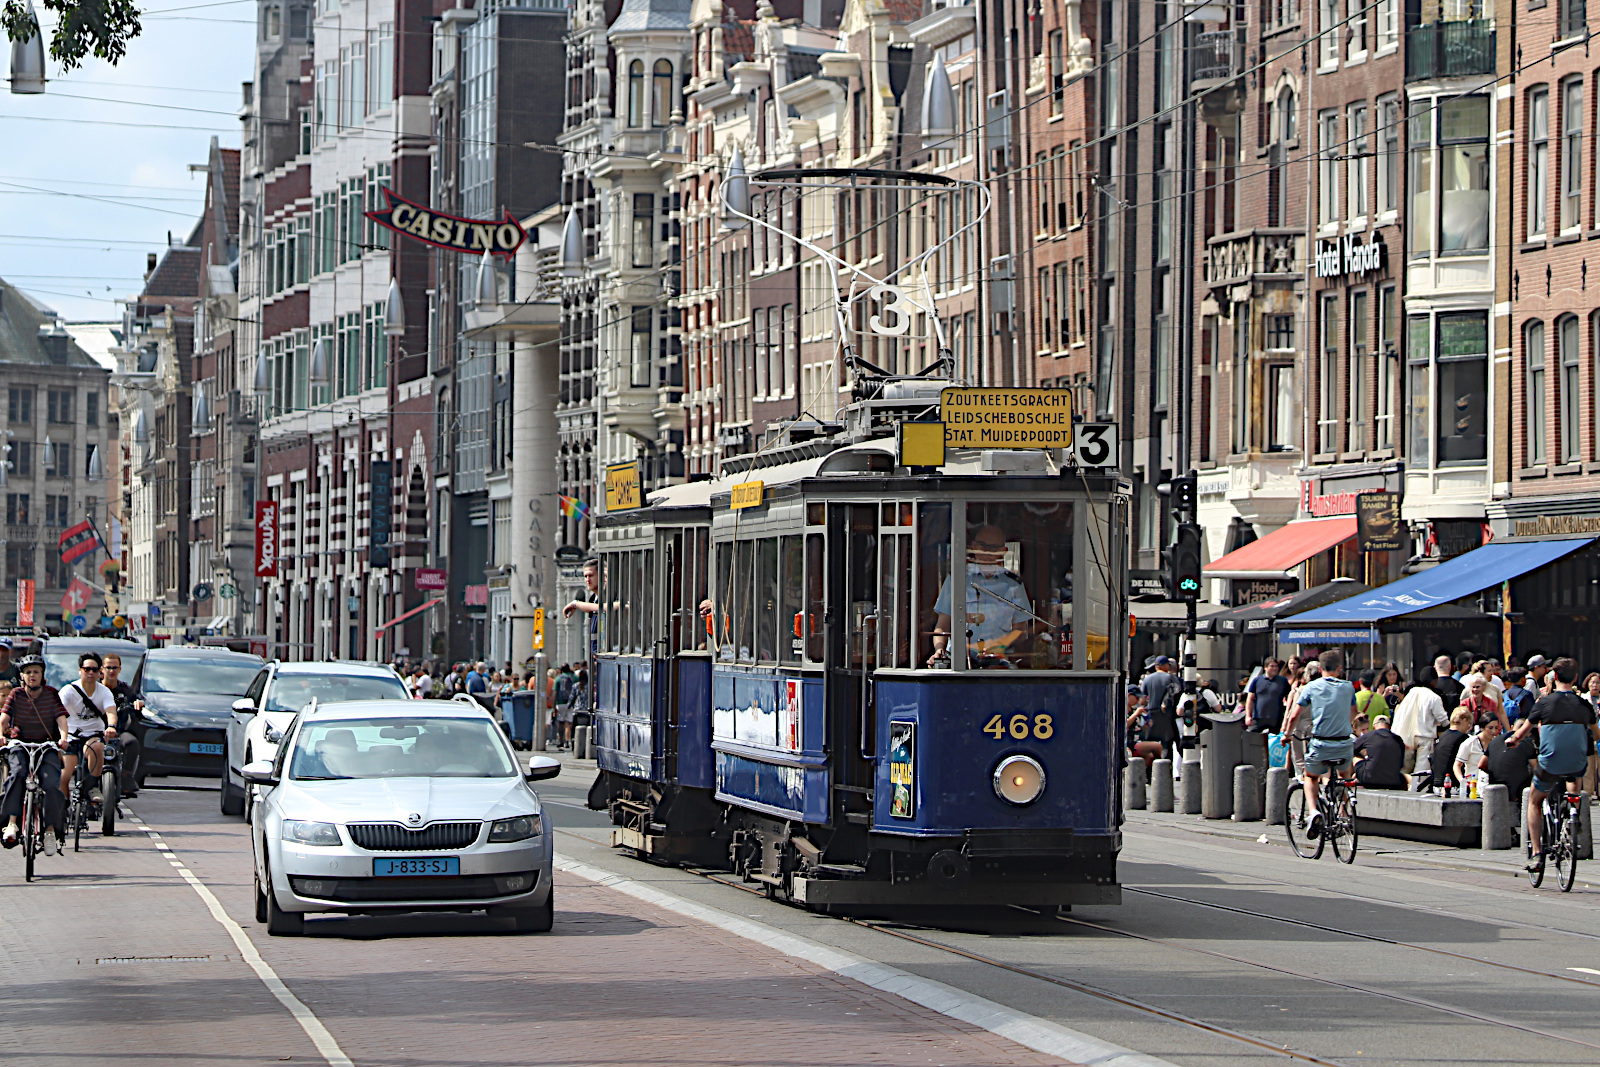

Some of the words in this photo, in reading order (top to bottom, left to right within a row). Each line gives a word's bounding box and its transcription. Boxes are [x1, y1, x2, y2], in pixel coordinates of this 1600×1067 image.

[391, 203, 521, 249] CASINO
[1315, 237, 1340, 278] Hotel
[869, 285, 910, 335] 3
[946, 392, 1068, 406] ZOUTKEETSGRACHT
[947, 410, 1065, 424] LEIDSCHEBOSCHJE
[945, 428, 977, 442] STAT.
[981, 428, 1068, 442] MUIDERPOORT
[1079, 425, 1110, 464] 3
[374, 472, 387, 557] PRIMARK
[1313, 489, 1357, 517] amsterdam
[528, 499, 541, 608] CASINO
[1251, 581, 1279, 593] Hotel
[1400, 620, 1464, 629] RESTAURANT
[982, 714, 1054, 740] 468
[386, 860, 448, 874] J-833-SJ
